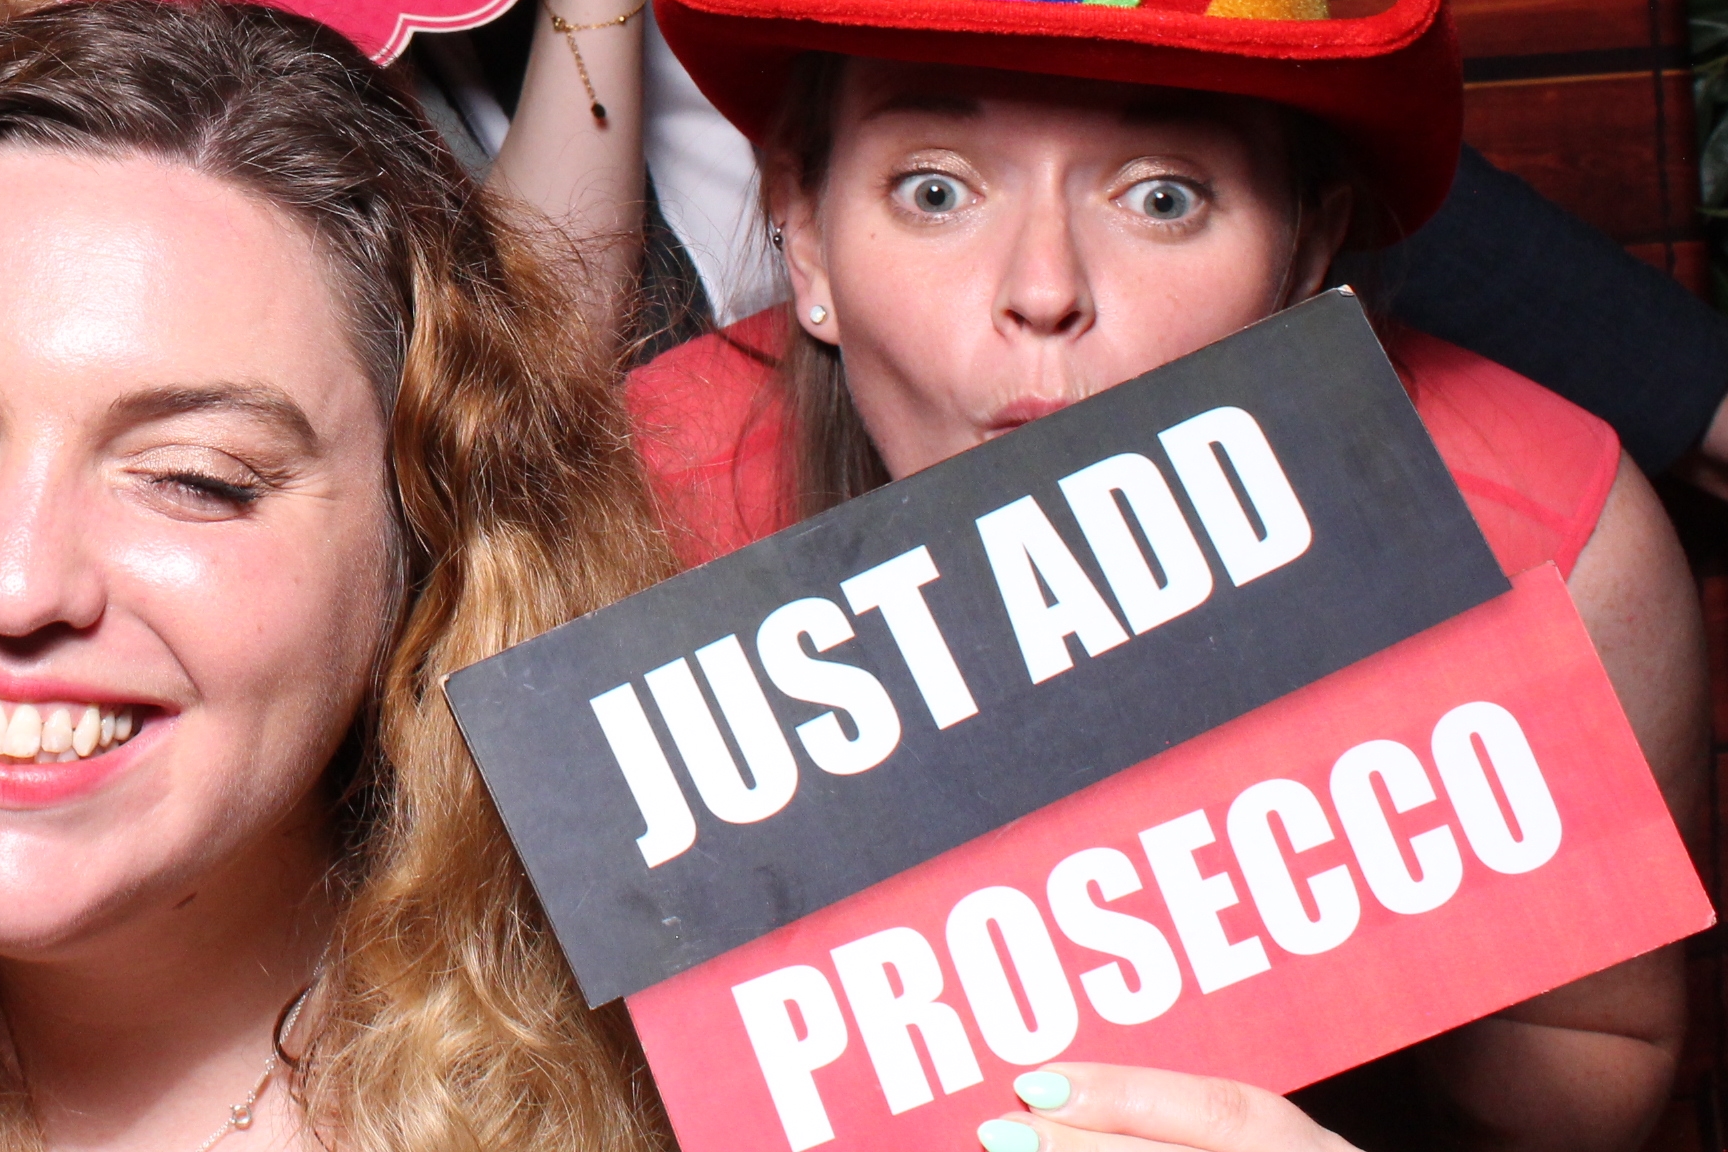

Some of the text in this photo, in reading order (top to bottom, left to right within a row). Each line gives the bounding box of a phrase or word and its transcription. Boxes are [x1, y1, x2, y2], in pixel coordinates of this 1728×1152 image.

[589, 405, 1313, 869] JUST ADD
[731, 701, 1564, 1152] PROSECCO
